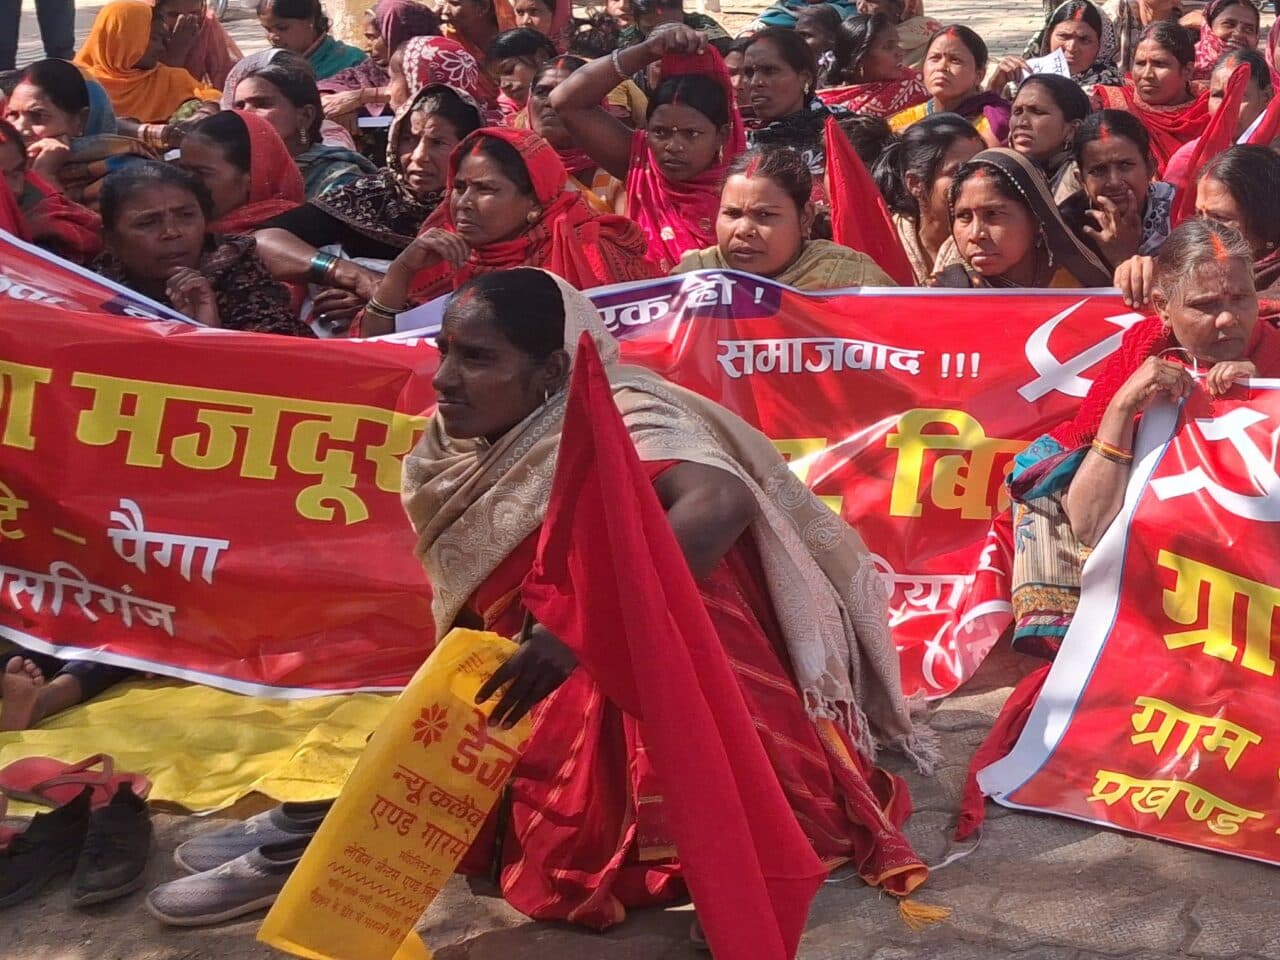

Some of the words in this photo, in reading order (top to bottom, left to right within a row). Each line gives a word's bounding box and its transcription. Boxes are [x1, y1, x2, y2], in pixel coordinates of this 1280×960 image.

[717, 337, 924, 379] समाजवाद
[940, 352, 980, 378] !!!
[107, 498, 229, 584] पैगा
[1129, 696, 1262, 768] ग्राम
[370, 794, 418, 837] एण्ड
[1086, 770, 1265, 837] प्रखण्ड
